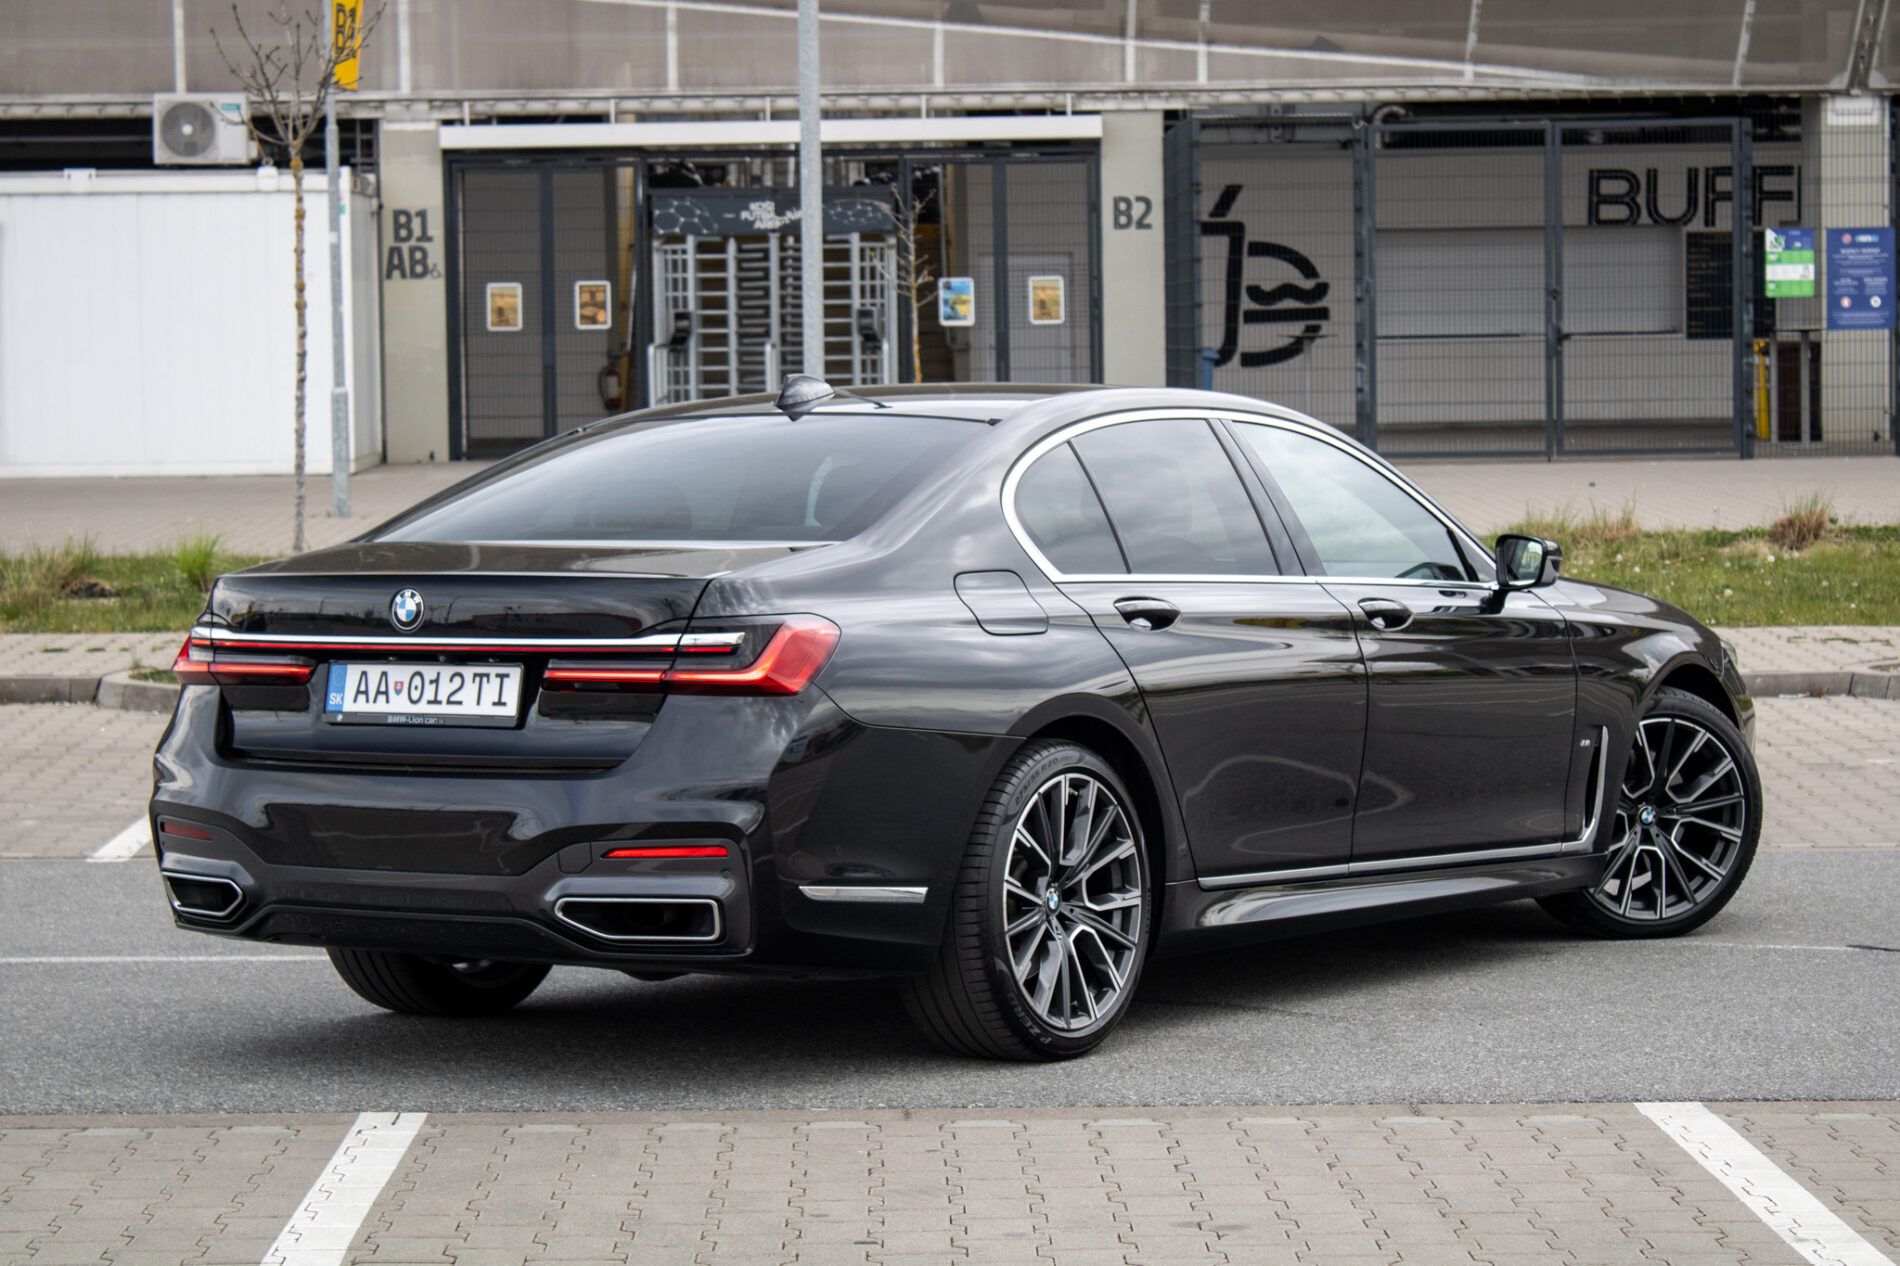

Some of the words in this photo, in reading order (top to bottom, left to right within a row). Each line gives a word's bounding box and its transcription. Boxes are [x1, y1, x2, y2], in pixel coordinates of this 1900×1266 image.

[1113, 196, 1152, 229] B2
[1588, 165, 1801, 227] BUFF
[393, 209, 434, 242] B1
[386, 246, 429, 279] AB
[329, 693, 343, 705] SK
[353, 671, 390, 704] AA
